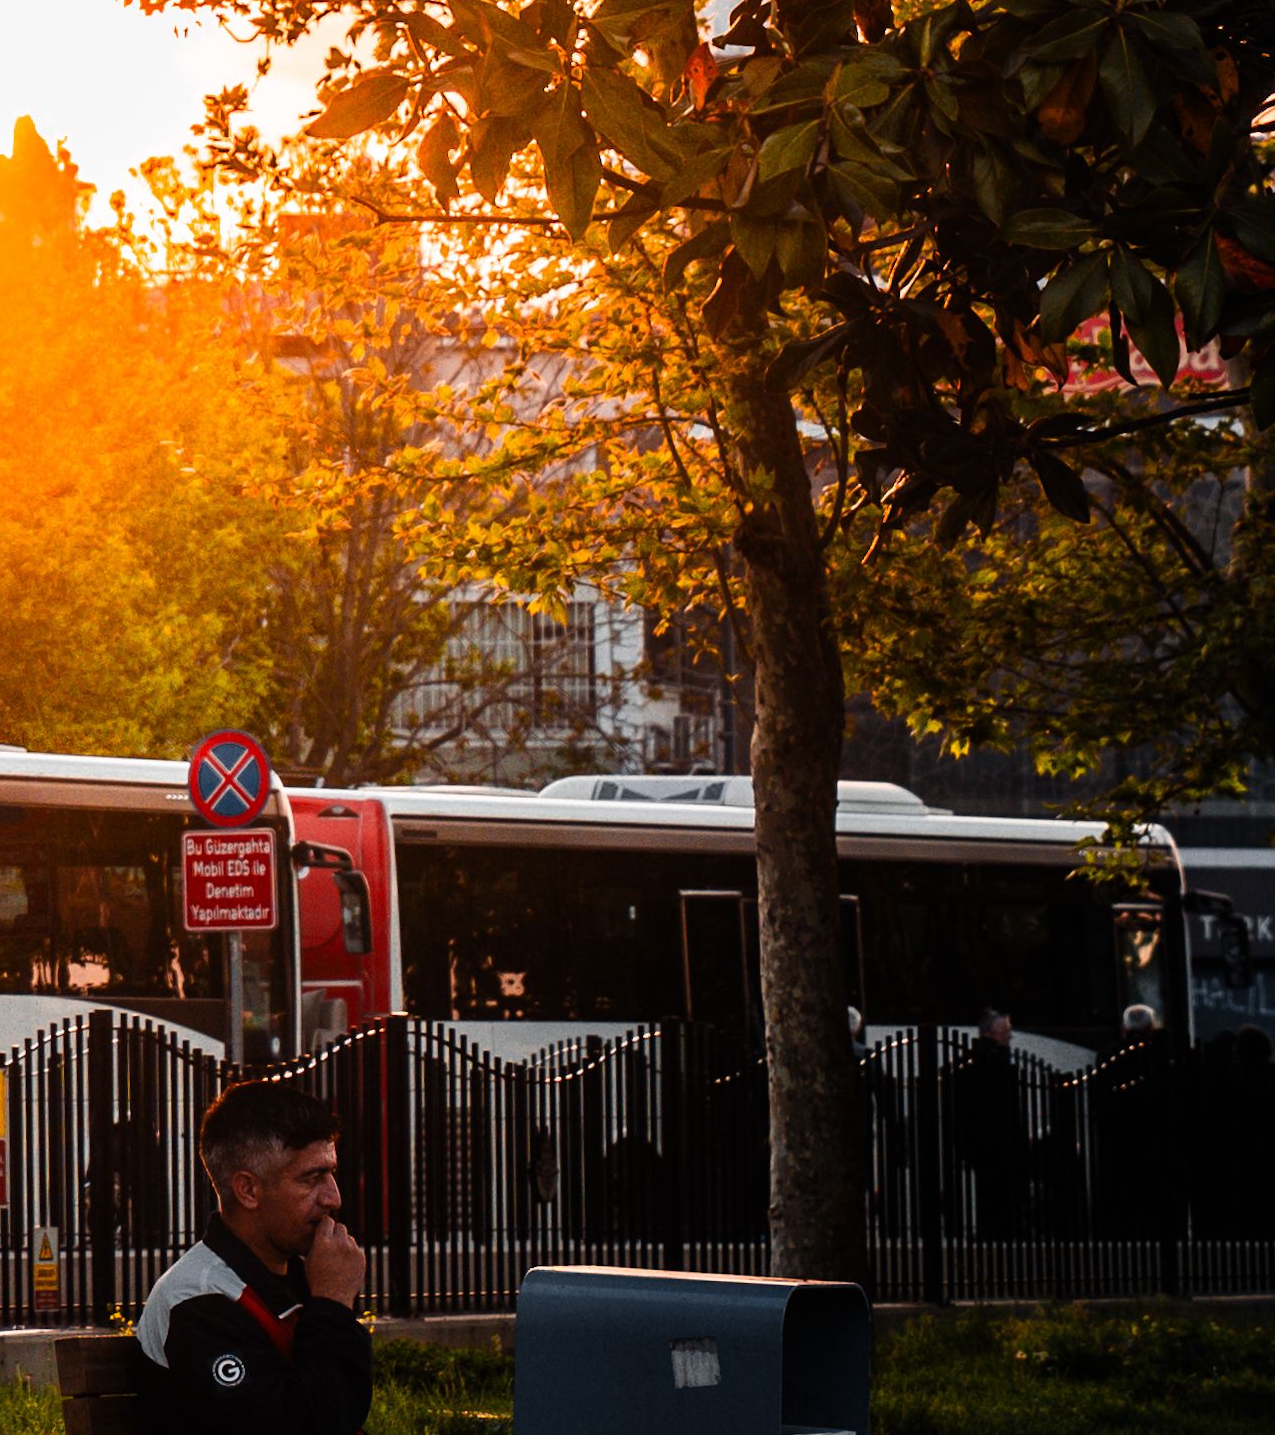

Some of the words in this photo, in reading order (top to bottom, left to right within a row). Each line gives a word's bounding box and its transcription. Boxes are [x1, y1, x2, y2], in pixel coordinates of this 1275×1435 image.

[186, 838, 202, 856] Bu
[193, 860, 224, 877] Mobil
[227, 859, 250, 877] EDS
[252, 860, 266, 876] ile
[205, 882, 254, 899] Denetim
[191, 904, 270, 925] Yapılmaktadır
